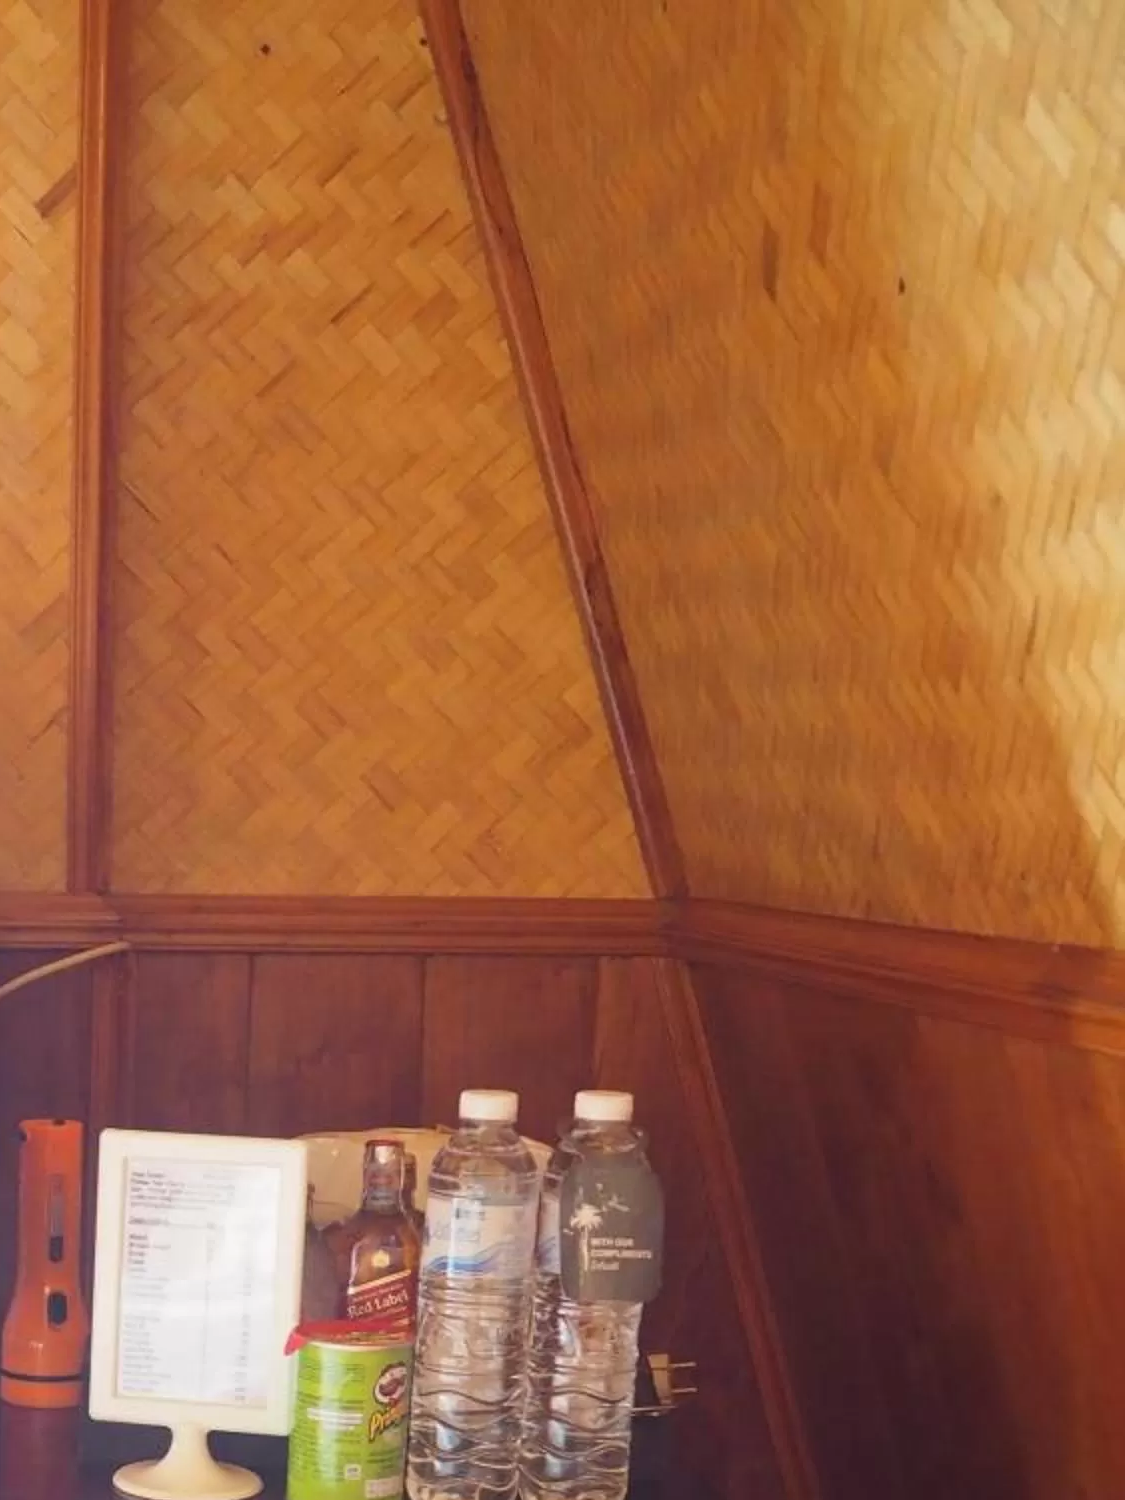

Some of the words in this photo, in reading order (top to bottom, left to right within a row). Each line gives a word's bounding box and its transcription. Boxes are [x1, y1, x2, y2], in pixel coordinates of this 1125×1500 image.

[590, 1237, 614, 1248] WITH
[615, 1237, 634, 1248] OUR
[590, 1249, 652, 1260] COMPLIMENTS
[347, 1301, 373, 1318] Red
[374, 1288, 409, 1310] Label
